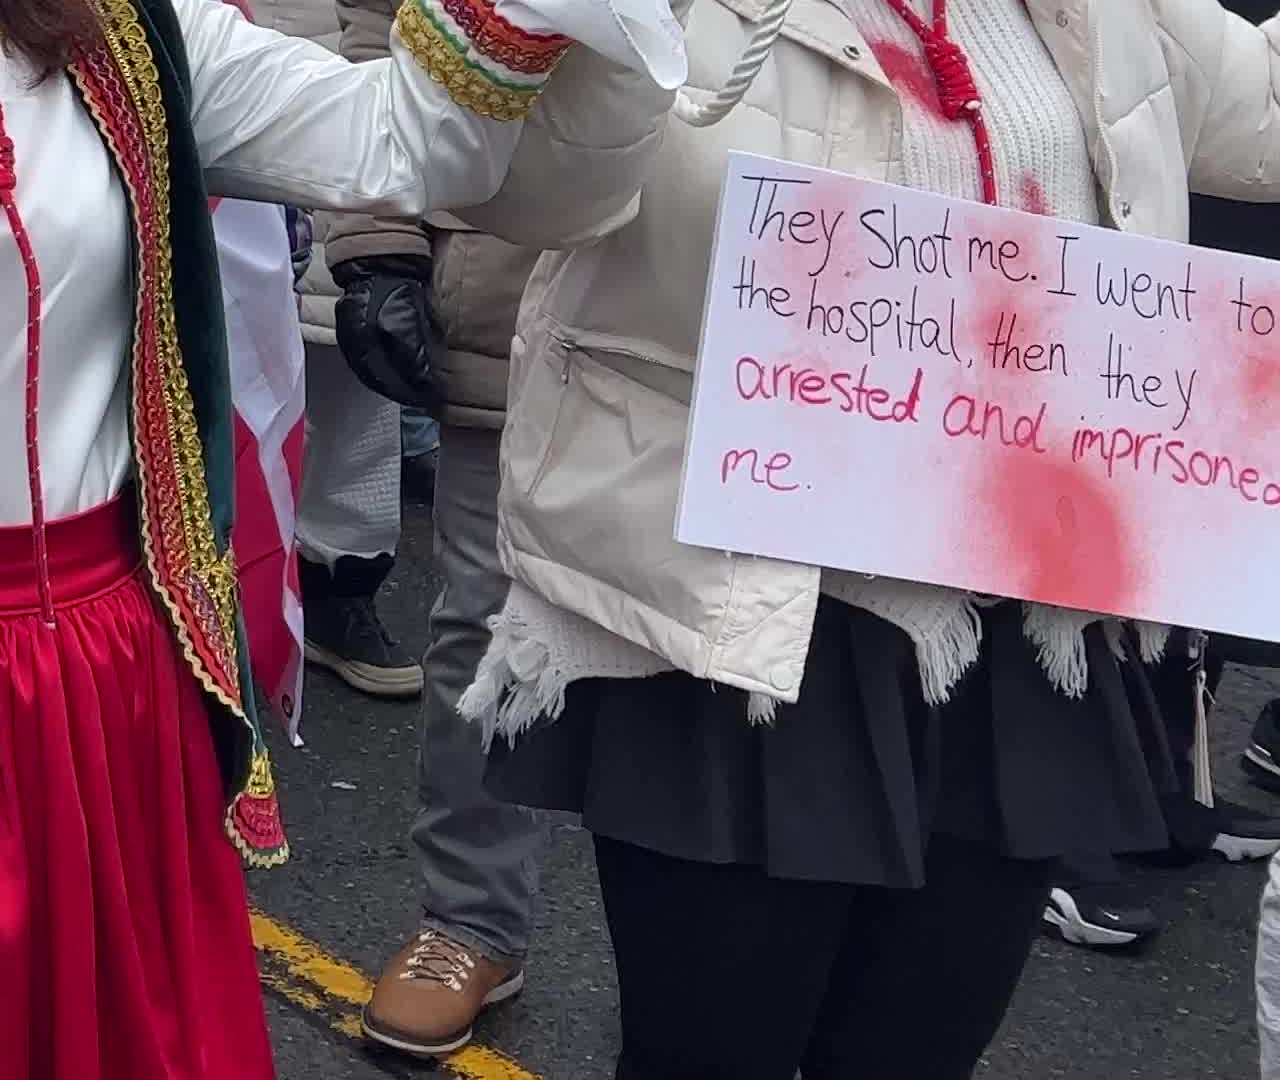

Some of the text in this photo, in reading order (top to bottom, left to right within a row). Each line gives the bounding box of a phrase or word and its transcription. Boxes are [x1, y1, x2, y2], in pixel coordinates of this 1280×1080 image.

[742, 174, 845, 277] They
[966, 231, 1039, 283] me.
[1046, 234, 1081, 297] I
[1230, 276, 1278, 337] to
[732, 256, 1198, 432] the hospital, then they
[734, 354, 925, 424] arrested
[942, 394, 1048, 456] and
[720, 444, 815, 494] me.
